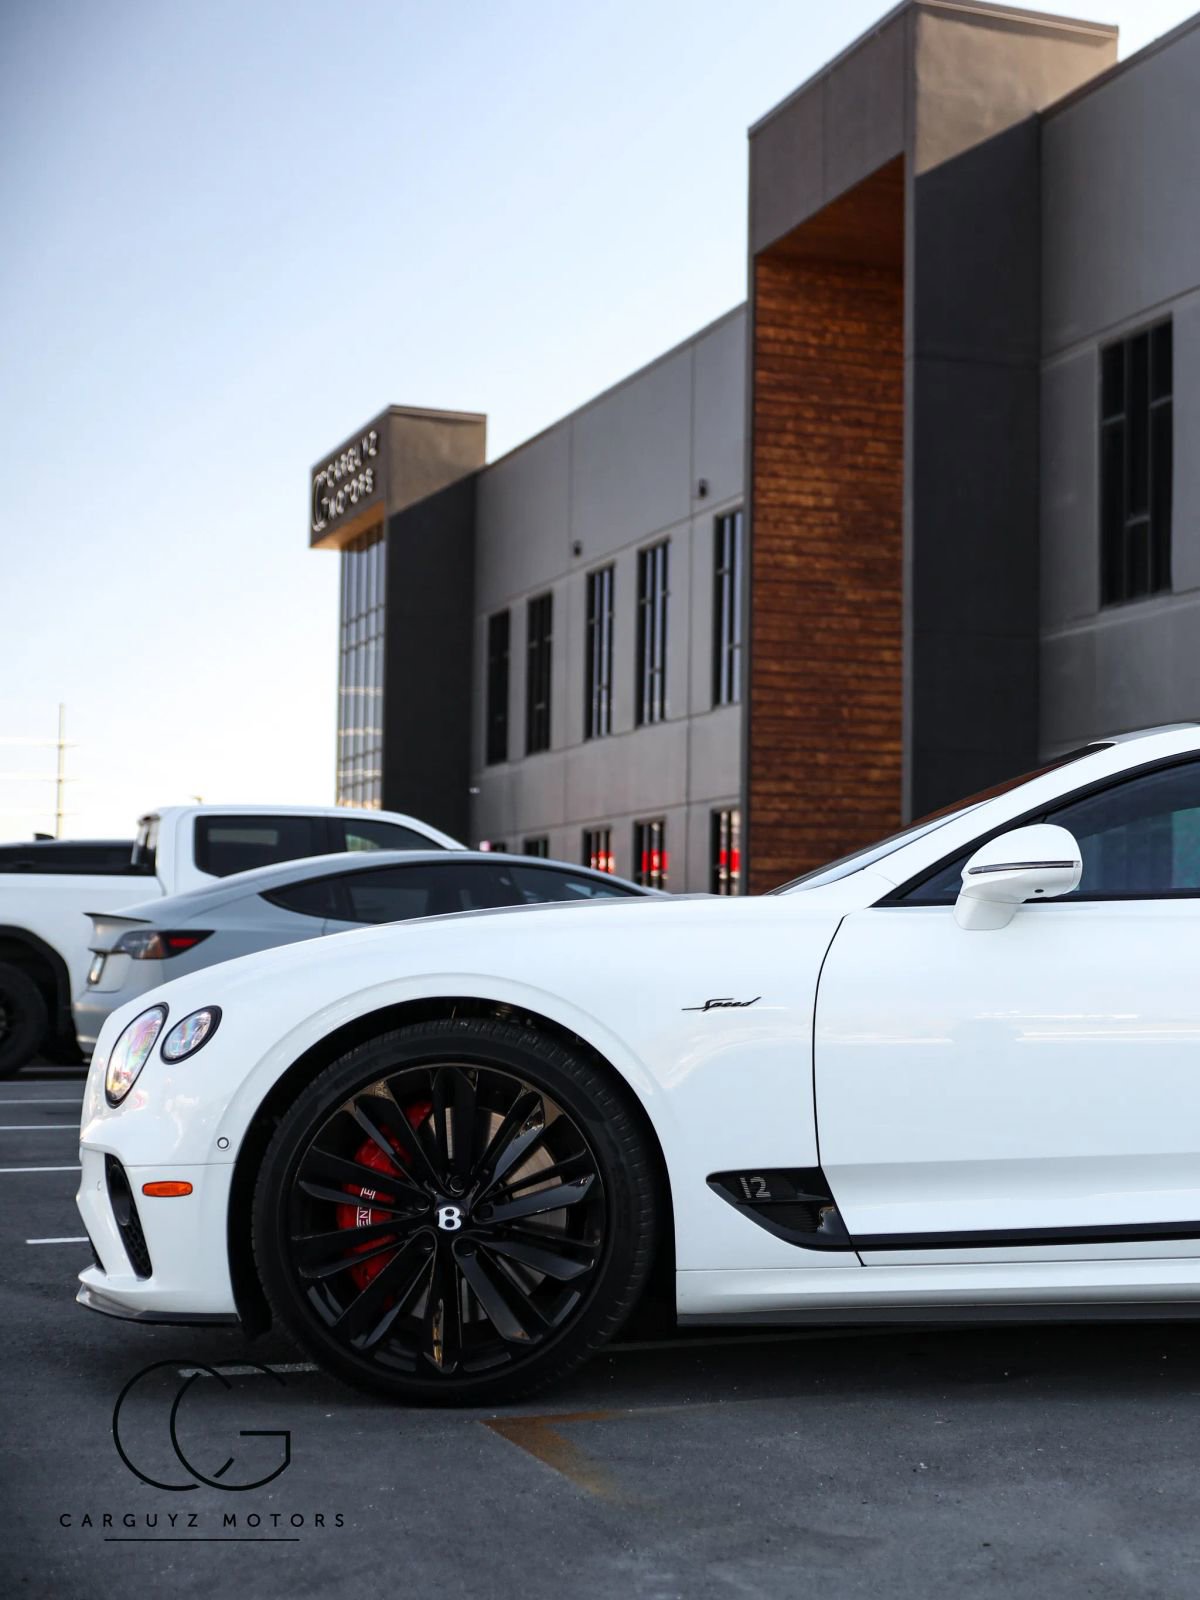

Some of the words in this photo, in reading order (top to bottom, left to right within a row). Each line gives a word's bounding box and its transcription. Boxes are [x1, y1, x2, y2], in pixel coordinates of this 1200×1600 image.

[682, 996, 762, 1012] Speed
[739, 1176, 771, 1199] 12
[438, 1206, 462, 1231] B
